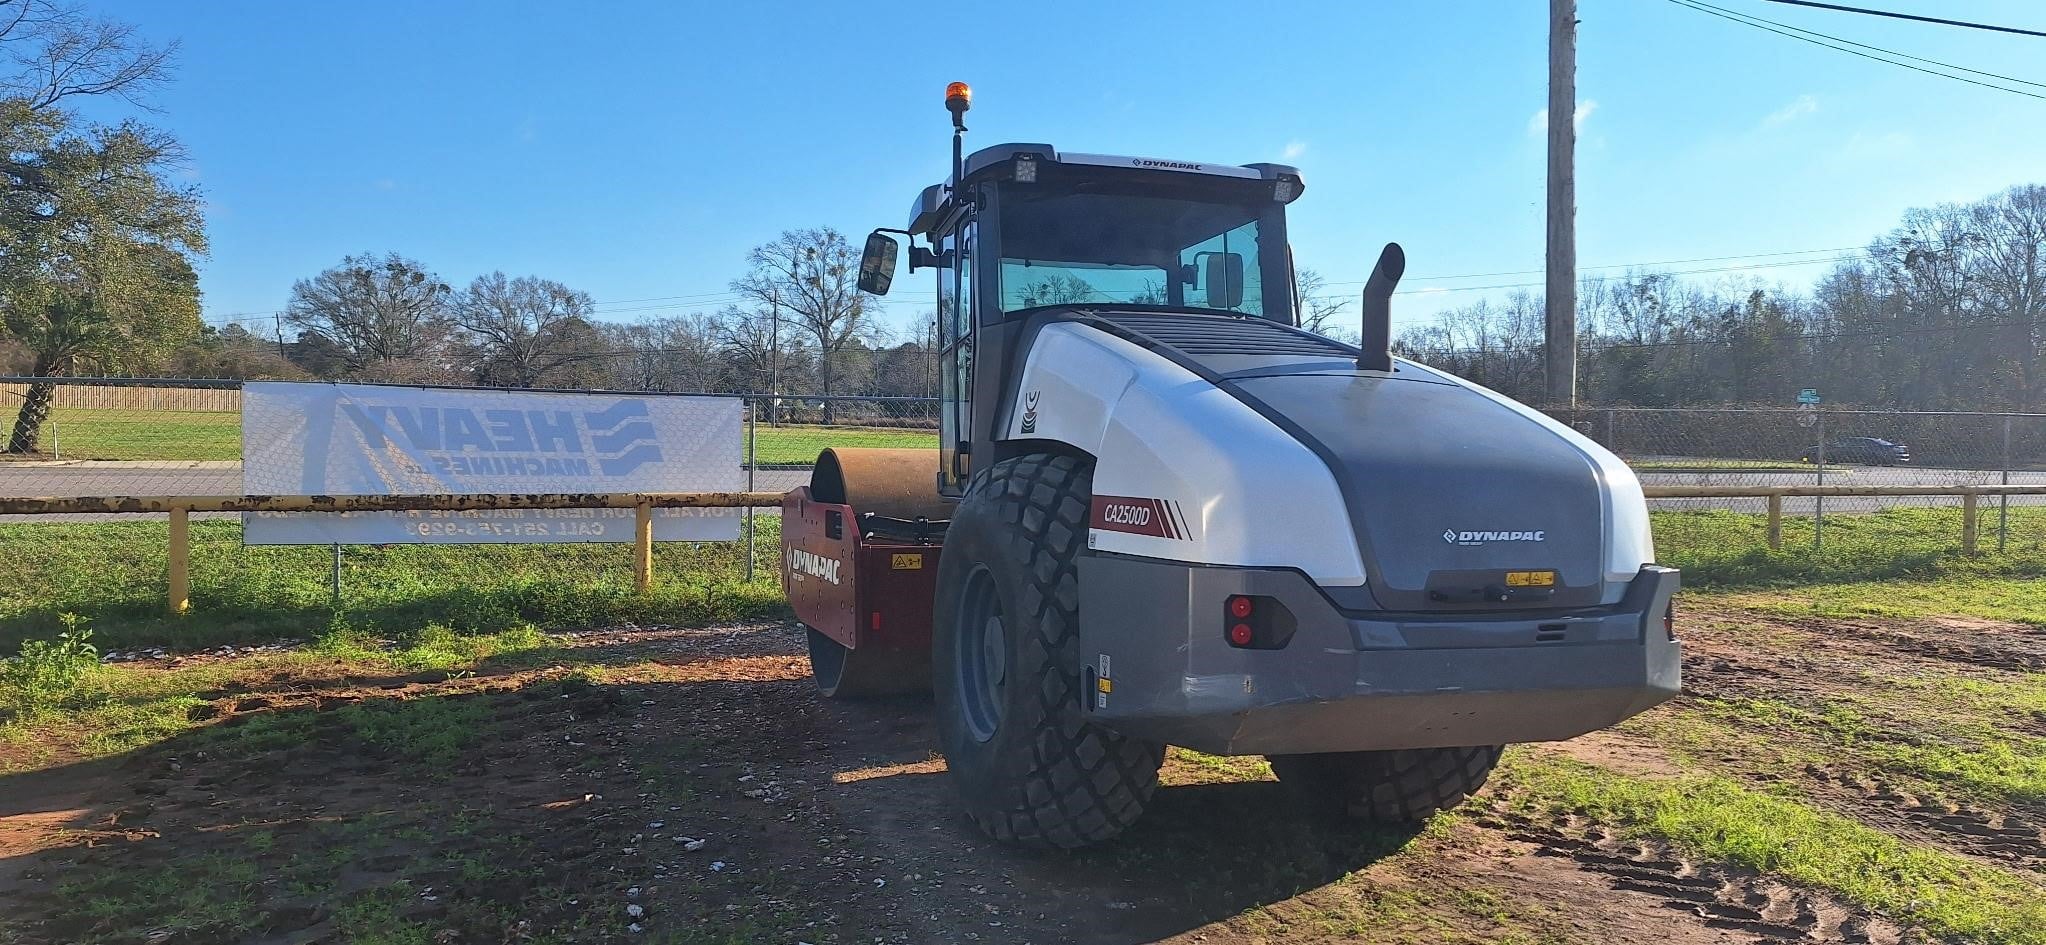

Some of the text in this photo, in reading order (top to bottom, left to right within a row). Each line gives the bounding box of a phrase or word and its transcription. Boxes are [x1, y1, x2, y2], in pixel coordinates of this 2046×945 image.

[1143, 160, 1203, 171] DYNAPAC
[1104, 504, 1150, 526] CA2500D
[1458, 530, 1545, 542] DYNAPAC
[792, 549, 841, 585] DYNAPAC
